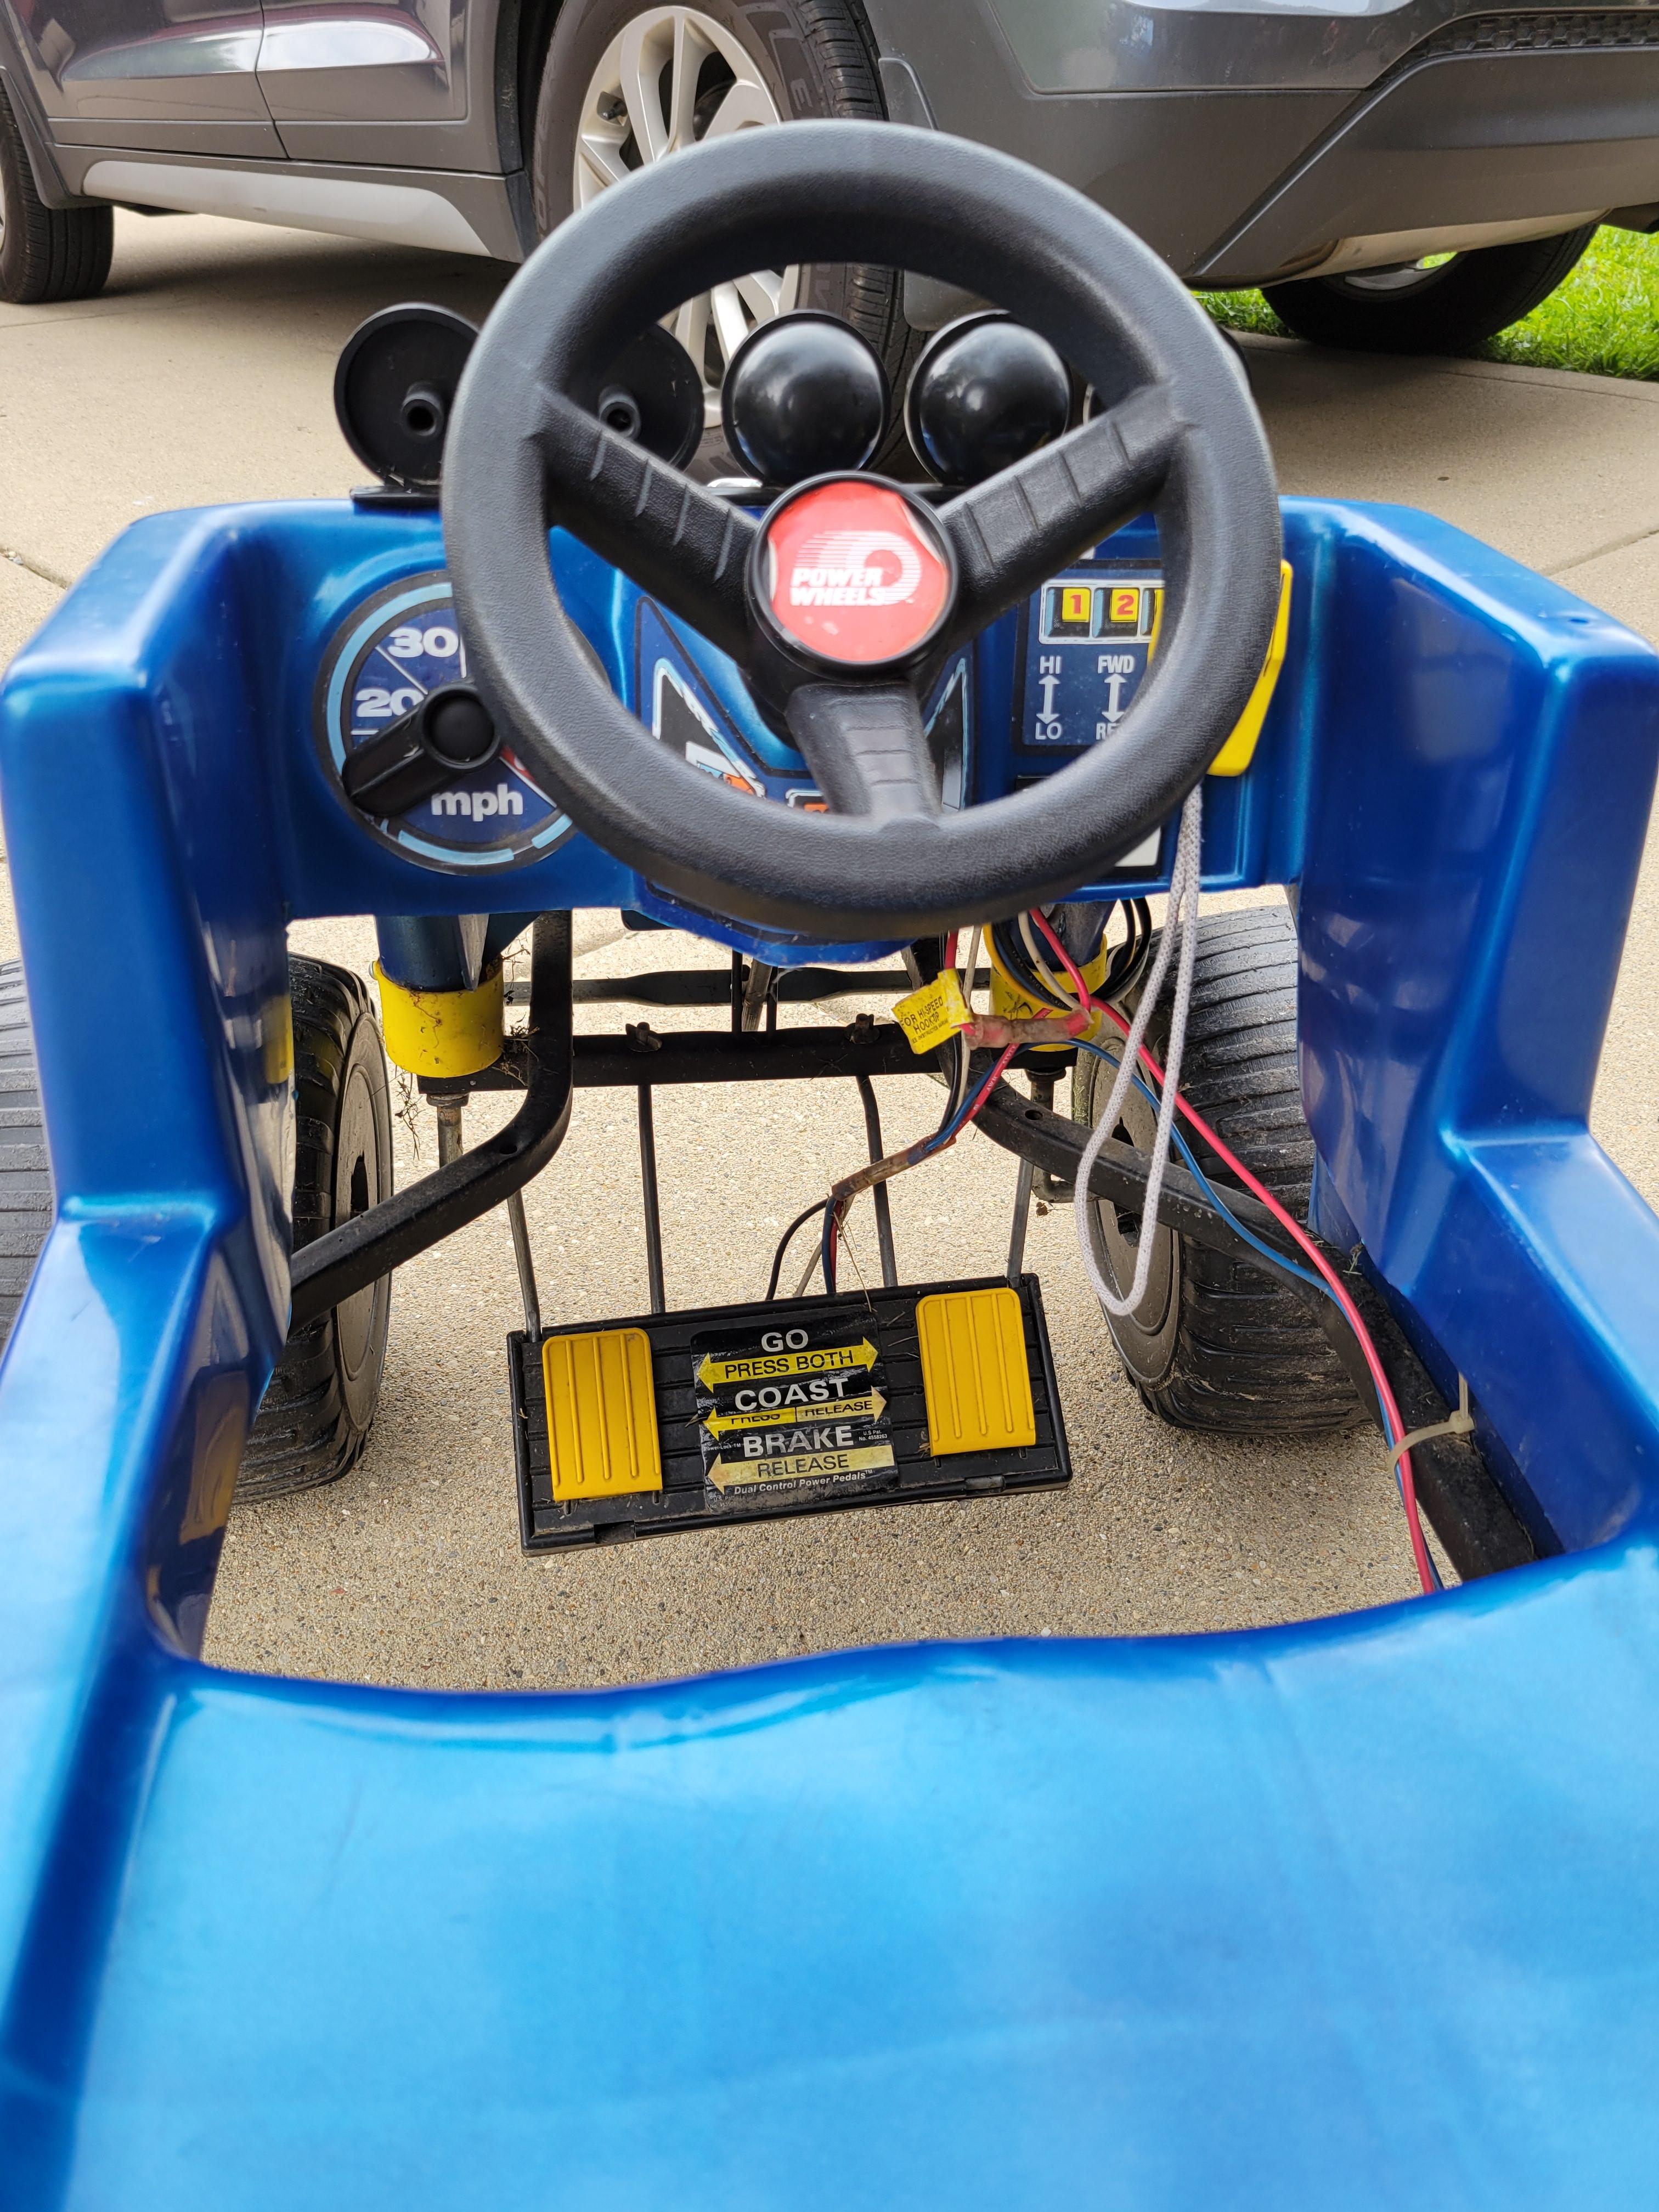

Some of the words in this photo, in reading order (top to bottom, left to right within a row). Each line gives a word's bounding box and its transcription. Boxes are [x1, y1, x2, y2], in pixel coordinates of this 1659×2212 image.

[791, 567, 882, 587] POWER
[790, 587, 886, 606] WHEELS
[1070, 595, 1081, 614] 1
[1116, 595, 1134, 615] 2
[387, 627, 459, 658] 30
[1040, 656, 1062, 674] HI
[1098, 655, 1135, 674] FWD
[356, 689, 424, 717] 20
[1035, 723, 1062, 740] LO
[1096, 723, 1120, 740] RE
[431, 783, 523, 822] mph
[761, 1329, 809, 1352] GO
[725, 1358, 790, 1379] PRESS
[796, 1350, 853, 1370] BOTH
[735, 1378, 848, 1412] COAST
[805, 1401, 873, 1417] RELEASE
[743, 1425, 854, 1458] BRAKE
[758, 1454, 849, 1478] RELEASE
[734, 1486, 756, 1495] Dual
[759, 1479, 795, 1491] Control
[799, 1477, 830, 1487] Power
